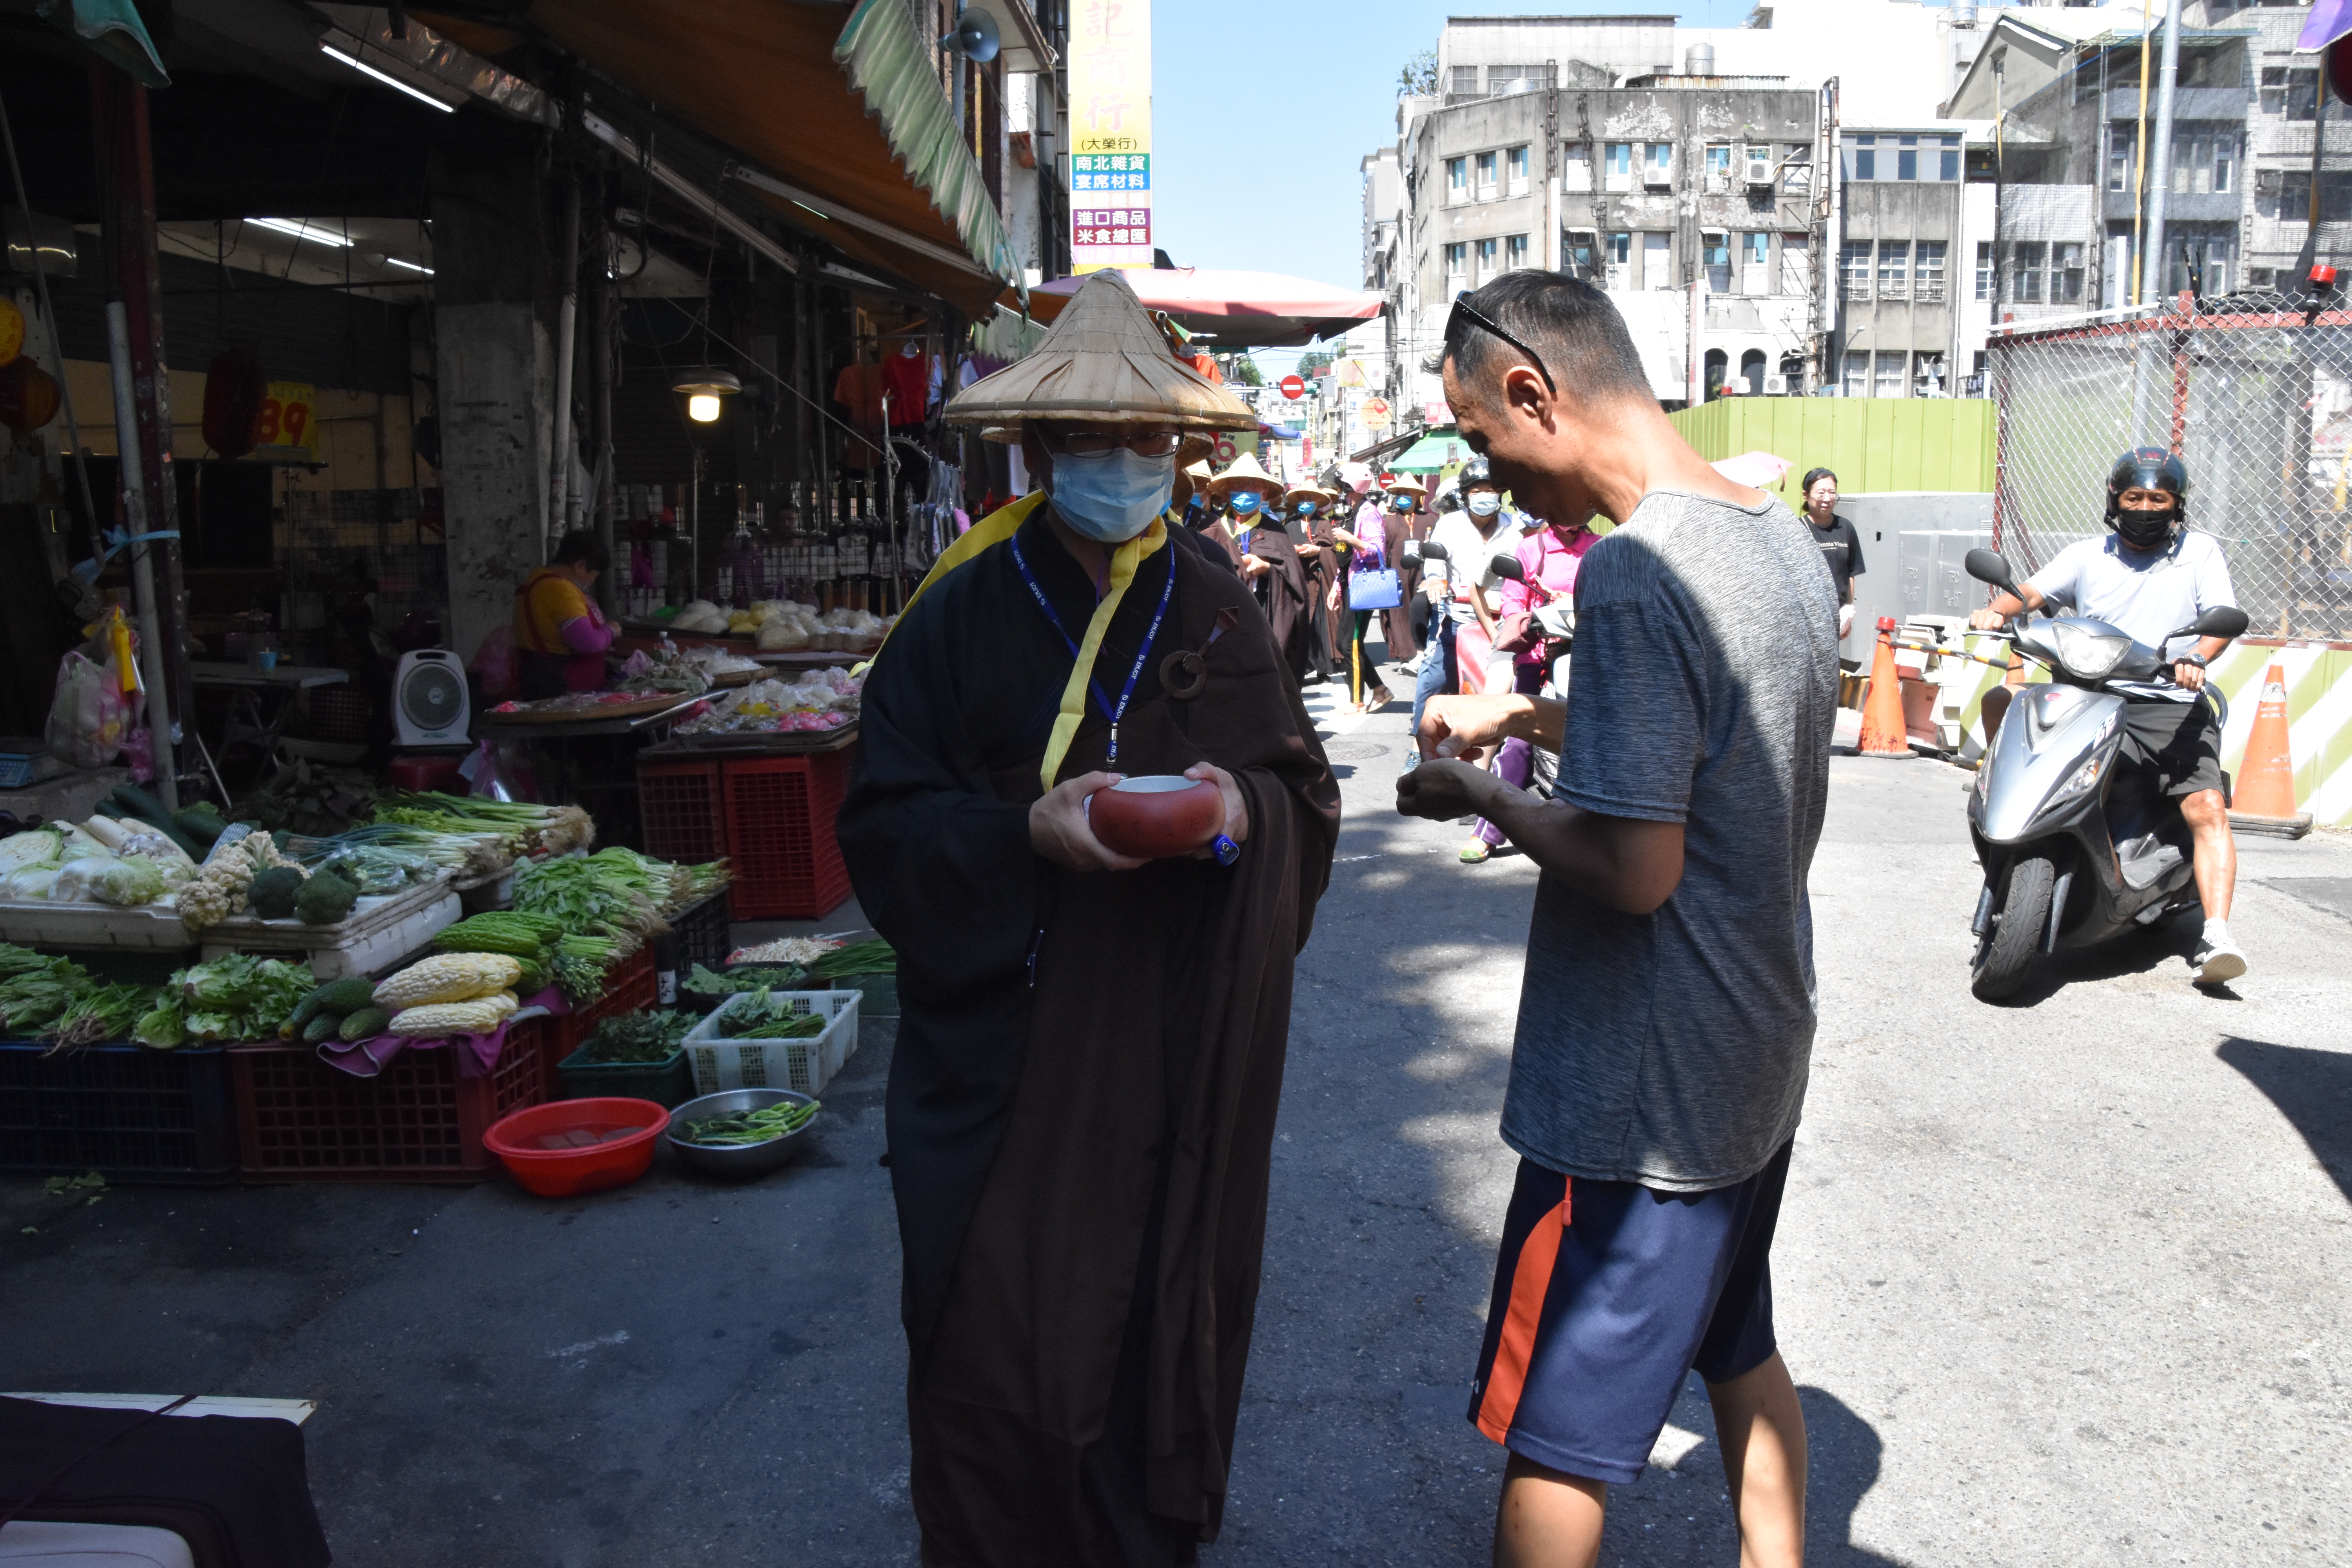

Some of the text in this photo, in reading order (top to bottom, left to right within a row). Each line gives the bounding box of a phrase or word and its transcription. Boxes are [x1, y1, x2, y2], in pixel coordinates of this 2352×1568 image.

[1082, 1, 1134, 132] 記商行
[1081, 138, 1138, 151] (大榮行)
[1076, 156, 1145, 171] 南北雜貨
[1075, 174, 1144, 189] 宴席材料
[1077, 211, 1145, 225] 進口商品
[1078, 229, 1146, 243] 米食總匯
[1079, 247, 1147, 262] 山珍海味
[1430, 404, 1452, 416] 防止
[1029, 581, 1042, 599] ENJOY
[1163, 584, 1172, 603] ENJOY
[1148, 622, 1158, 641] ENJOY
[1131, 660, 1142, 680] ENJOY
